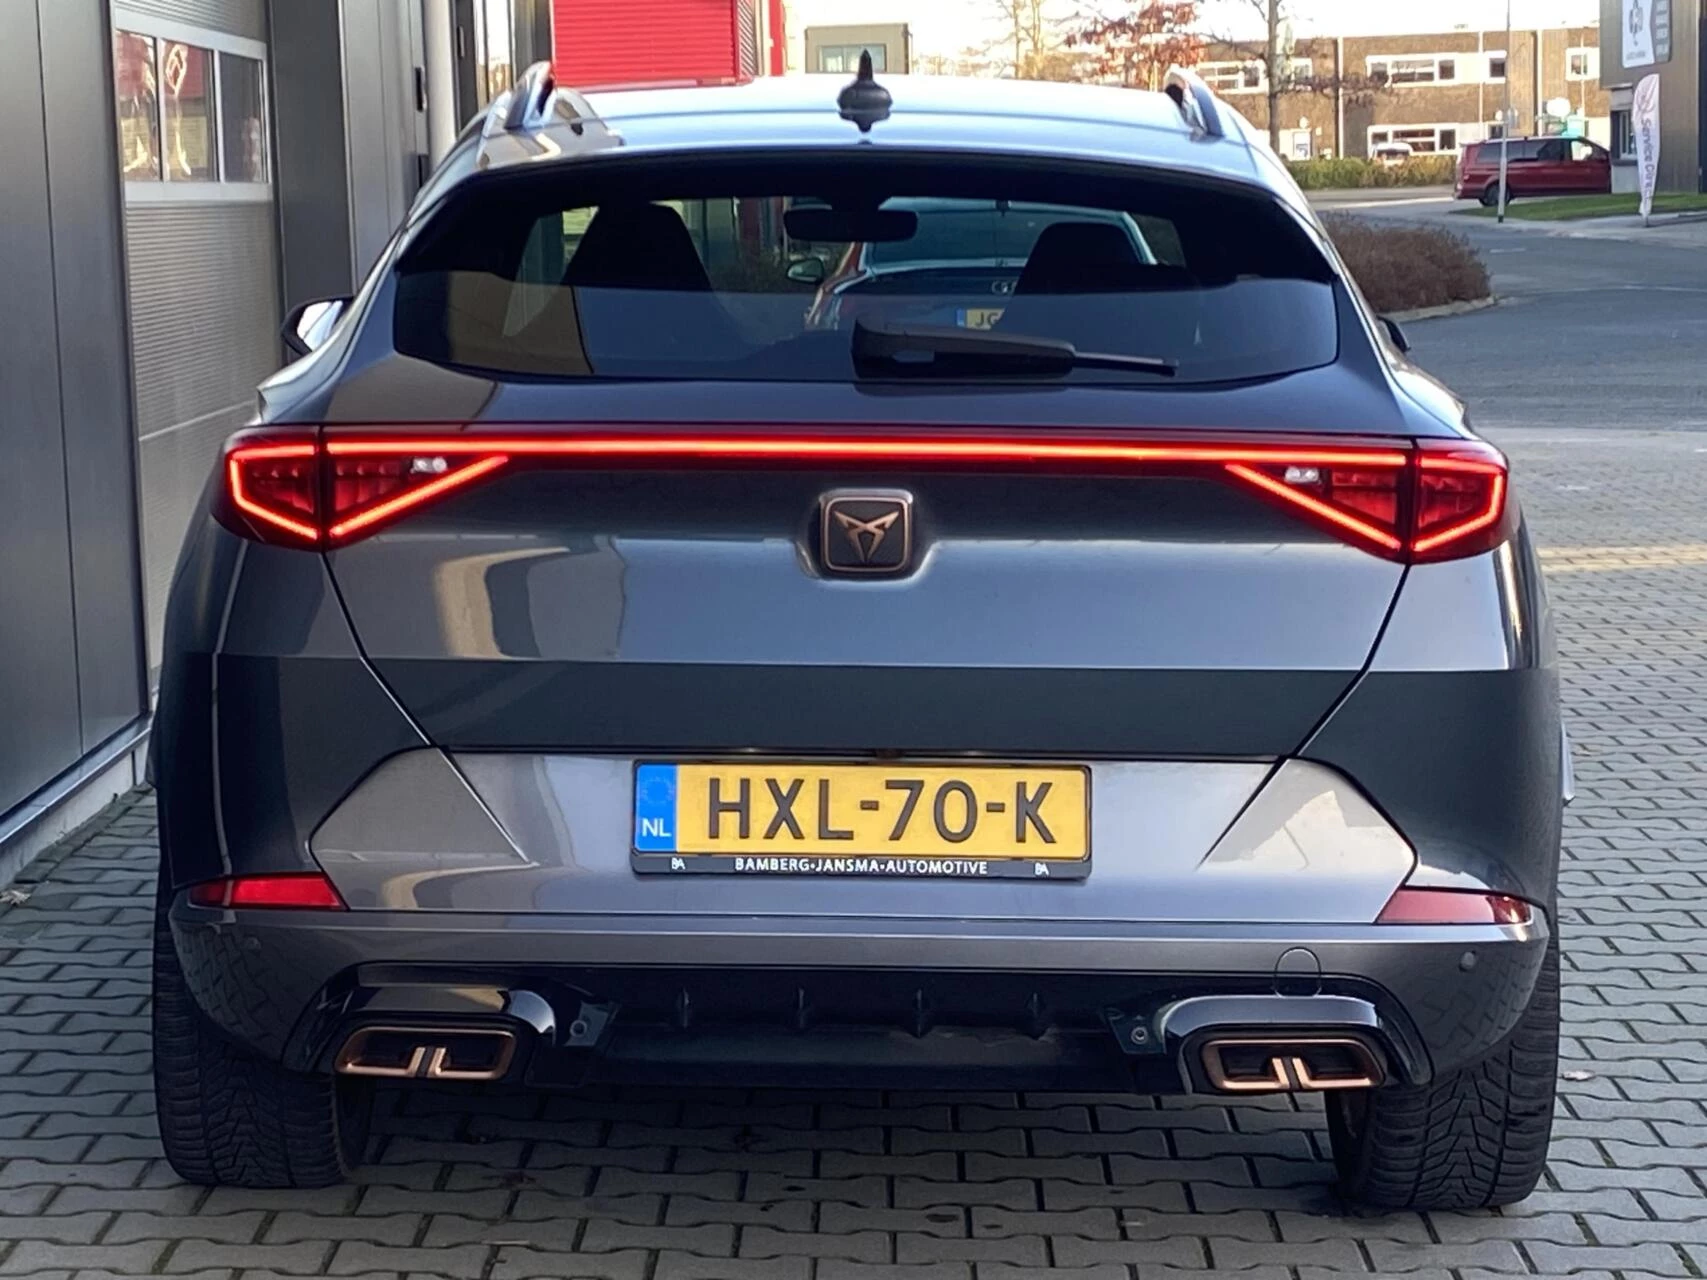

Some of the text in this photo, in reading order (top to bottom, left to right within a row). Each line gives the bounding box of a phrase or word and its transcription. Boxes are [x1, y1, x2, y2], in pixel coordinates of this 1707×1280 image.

[1640, 118, 1653, 162] Service
[641, 817, 672, 837] NL
[707, 776, 1057, 845] HXL-70-K
